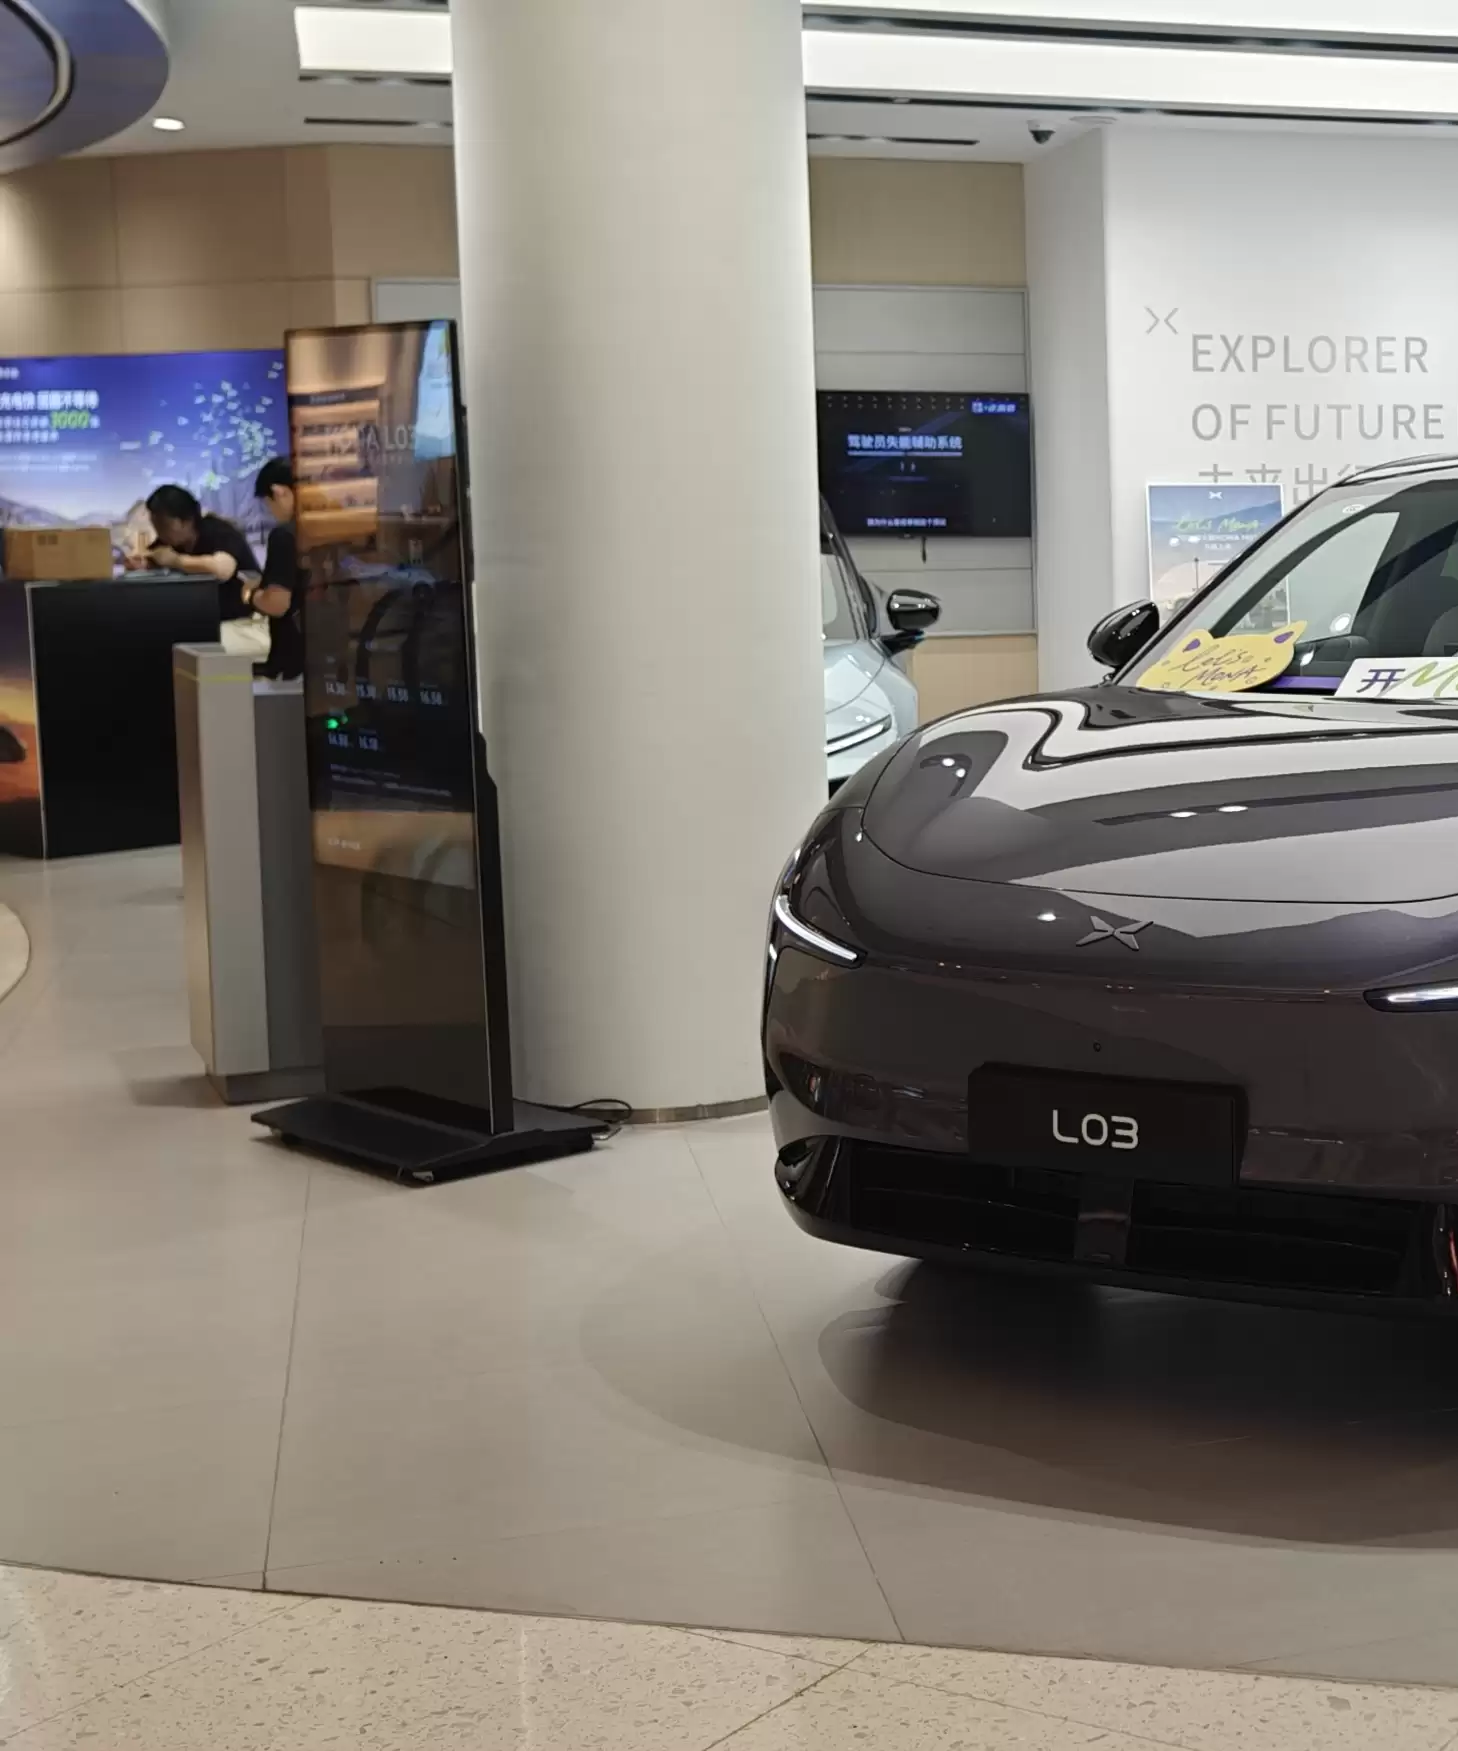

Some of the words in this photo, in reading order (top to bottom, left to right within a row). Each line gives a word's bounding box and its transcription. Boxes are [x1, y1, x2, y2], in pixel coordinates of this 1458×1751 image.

[1191, 333, 1429, 374] EXPLORER
[1191, 402, 1252, 442] OF
[1266, 403, 1445, 441] FUTURE
[1052, 1109, 1139, 1149] L03
